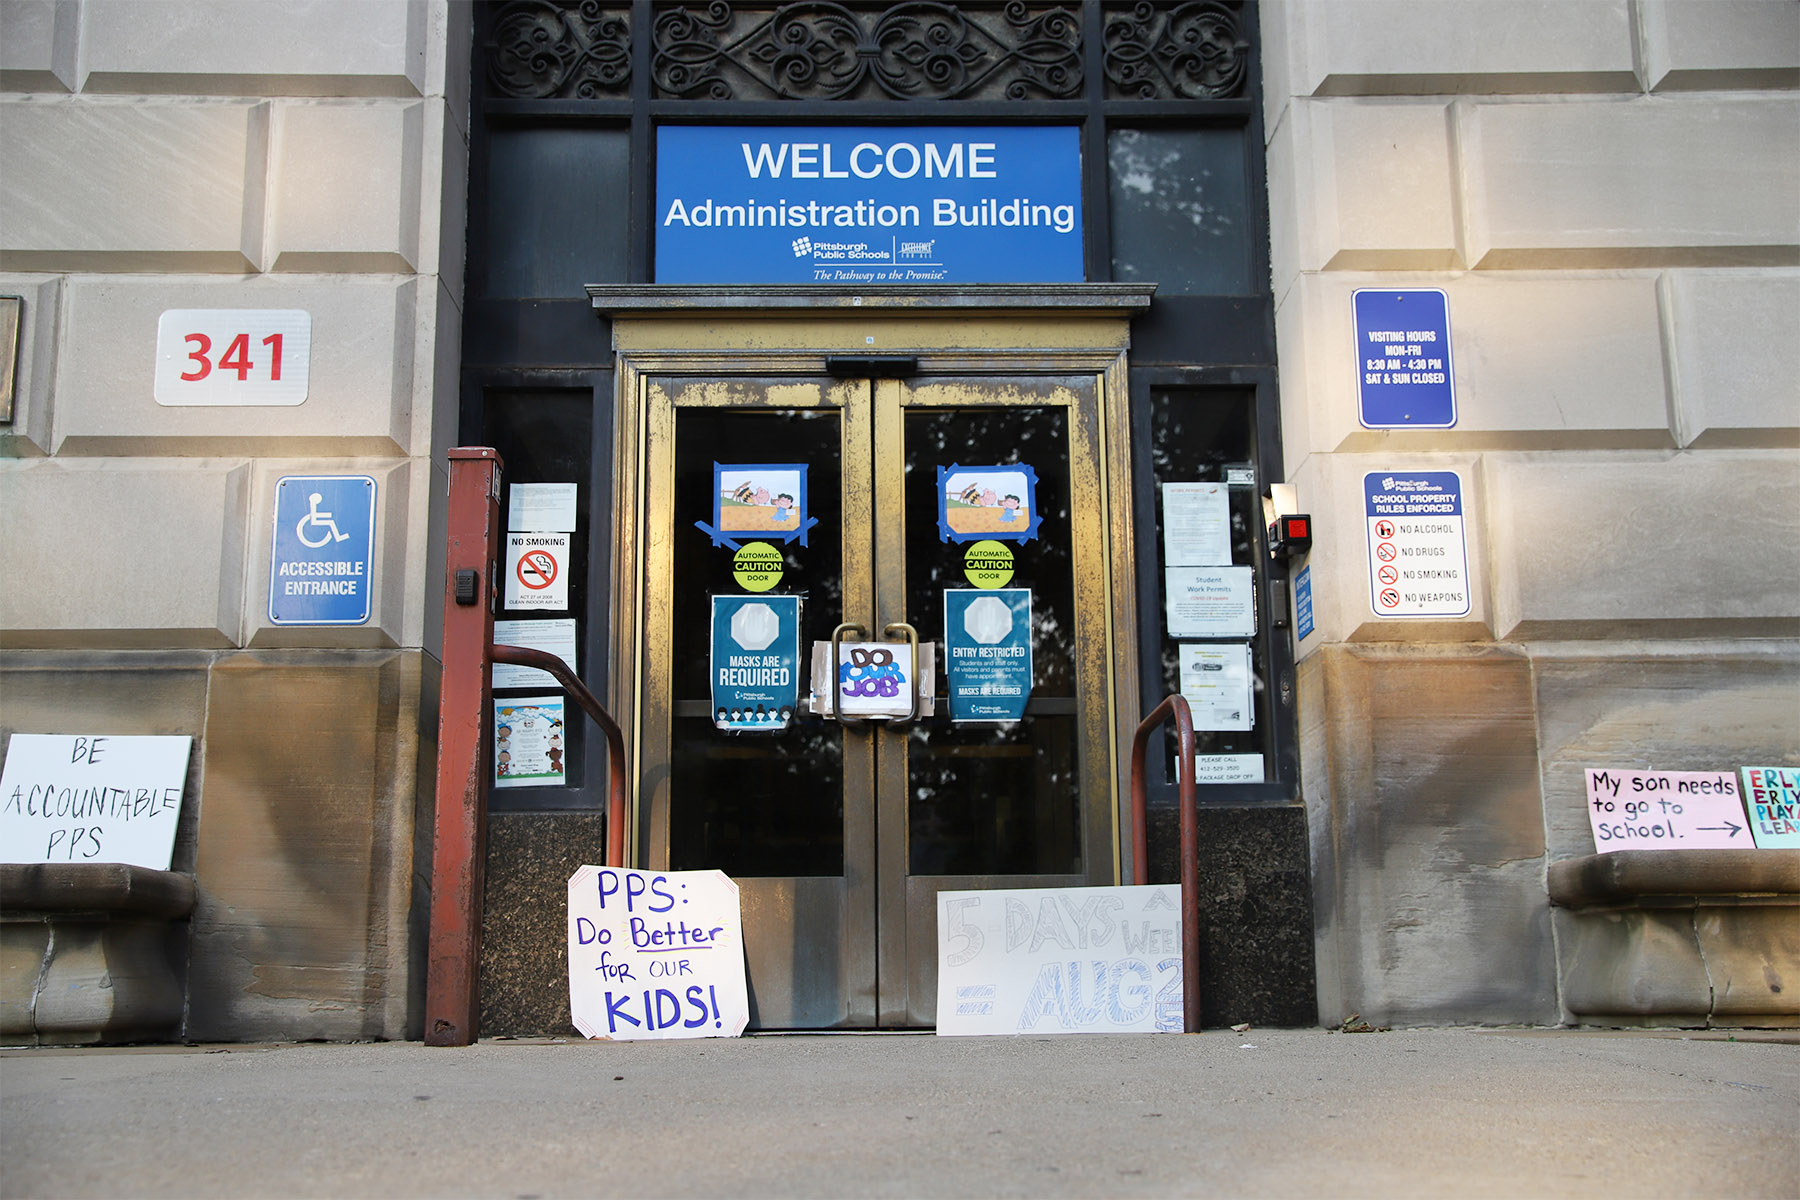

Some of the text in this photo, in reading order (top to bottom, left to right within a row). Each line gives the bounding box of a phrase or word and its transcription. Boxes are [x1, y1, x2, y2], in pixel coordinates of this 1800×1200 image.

[742, 143, 997, 179] WELCOME
[664, 198, 1075, 233] Administration Building
[813, 242, 868, 251] Pittsburgh
[813, 251, 890, 259] Public Schools
[813, 270, 832, 280] The
[834, 270, 875, 283] Pathway
[876, 271, 887, 280] to
[888, 270, 904, 280] the
[1368, 331, 1436, 342] VISITING HOURS
[180, 333, 284, 382] 341
[1385, 345, 1422, 356] MON-FRI
[1366, 359, 1386, 370] 8:30
[1387, 359, 1401, 370] AM
[1408, 359, 1427, 370] 4:30
[1428, 359, 1442, 370] PM
[1365, 372, 1445, 384] SAT & SUN CLOSED
[1372, 494, 1456, 503] SCHOOL PROPERTY
[1376, 504, 1454, 513] RULES ENFORCED
[1400, 524, 1454, 533] NO ALCOHOL
[511, 538, 565, 546] NO SMOKING
[737, 552, 779, 560] AUTOMATIC
[968, 550, 1010, 558] AUTOMATIC
[1401, 547, 1445, 556] NO DRUGS
[279, 561, 363, 577] ACCESSIBLE
[735, 562, 782, 572] CAUTION
[966, 560, 1013, 570] CAUTION
[1403, 570, 1458, 579] NO SMOKING
[285, 580, 356, 596] ENTRANCE
[1405, 593, 1463, 602] NO WEAPONS
[850, 648, 893, 669] DO
[952, 647, 1025, 658] ENTRY RESTRICTED
[729, 656, 780, 667] MASKS ARE
[719, 669, 790, 687] REQUIRED
[842, 675, 900, 698] JOB
[958, 687, 1021, 696] MASKS ARE REQUIRED
[71, 737, 109, 764] BE
[1593, 771, 1735, 797] My son needs
[4, 784, 180, 821] ACCOUNTABLE
[1593, 797, 1683, 821] to go to
[1756, 804, 1794, 821] PLAY
[47, 826, 103, 860] PPS
[598, 870, 688, 913] PPS:
[577, 917, 724, 948] Do Better
[946, 887, 1178, 967] 5 DAYS A
[1121, 919, 1182, 955] WEE
[649, 959, 693, 978] OUR
[1016, 957, 1153, 1030] AUG
[604, 984, 722, 1033] KIDS!
